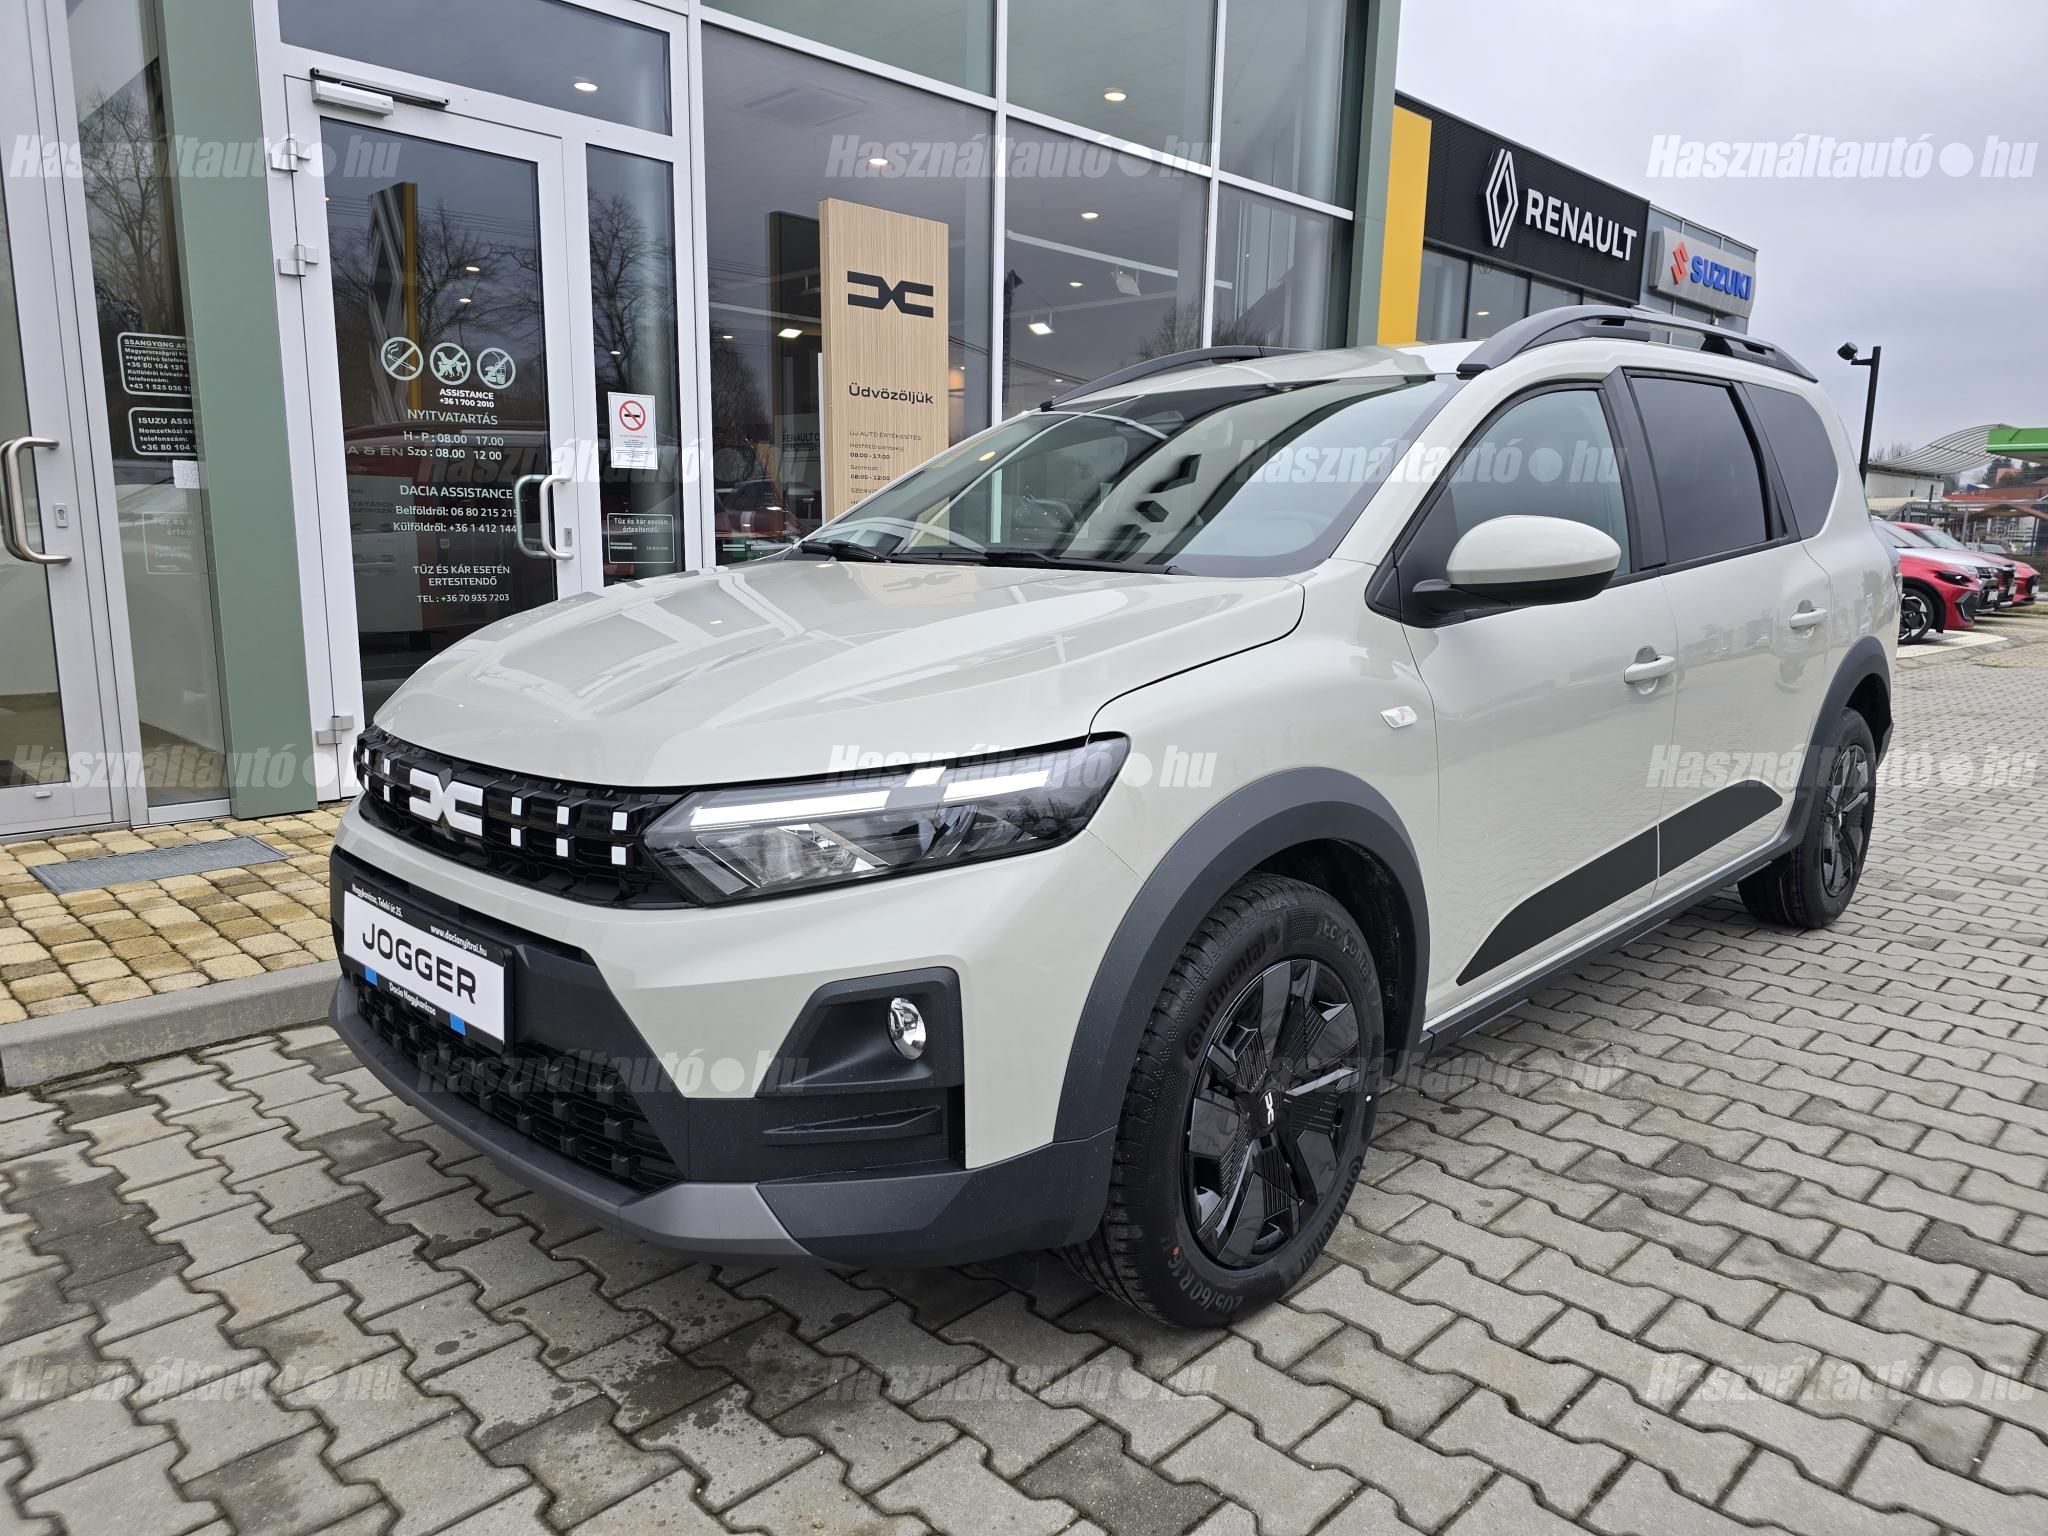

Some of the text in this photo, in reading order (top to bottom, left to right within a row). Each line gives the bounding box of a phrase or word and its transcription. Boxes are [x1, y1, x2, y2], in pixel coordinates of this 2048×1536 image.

[1525, 188, 1637, 261] RENAULT
[1690, 255, 1752, 300] SUZUKI
[124, 339, 175, 348] SSANGYONG
[439, 388, 494, 400] ASSISTANCE
[849, 382, 934, 405] Üdvözöljük
[460, 399, 475, 407] 700
[477, 400, 495, 408] 2010
[138, 417, 168, 425] ISUZU
[407, 409, 498, 425] NYITVATARTÁS
[437, 433, 468, 444] 08.00
[475, 435, 504, 447] 17.00
[141, 443, 159, 451] +36
[160, 443, 172, 451] 80
[435, 448, 466, 459] 08.00
[400, 485, 514, 499] DACIA ASSISTANCE
[395, 505, 449, 516] Belföldről:
[450, 507, 464, 517] 06
[465, 508, 479, 517] 80
[480, 508, 499, 517] 215
[393, 521, 447, 532] Külföldről:
[449, 523, 468, 533] +36
[471, 524, 476, 533] 1
[478, 524, 497, 533] 412
[412, 563, 510, 574] TŰZ ÉS KÁR ESETÉN
[441, 594, 457, 602] +36
[459, 594, 470, 602] 70
[471, 594, 488, 602] 935
[489, 594, 510, 602] 7203
[362, 922, 476, 1005] JOGGER
[389, 981, 404, 998] Dacia
